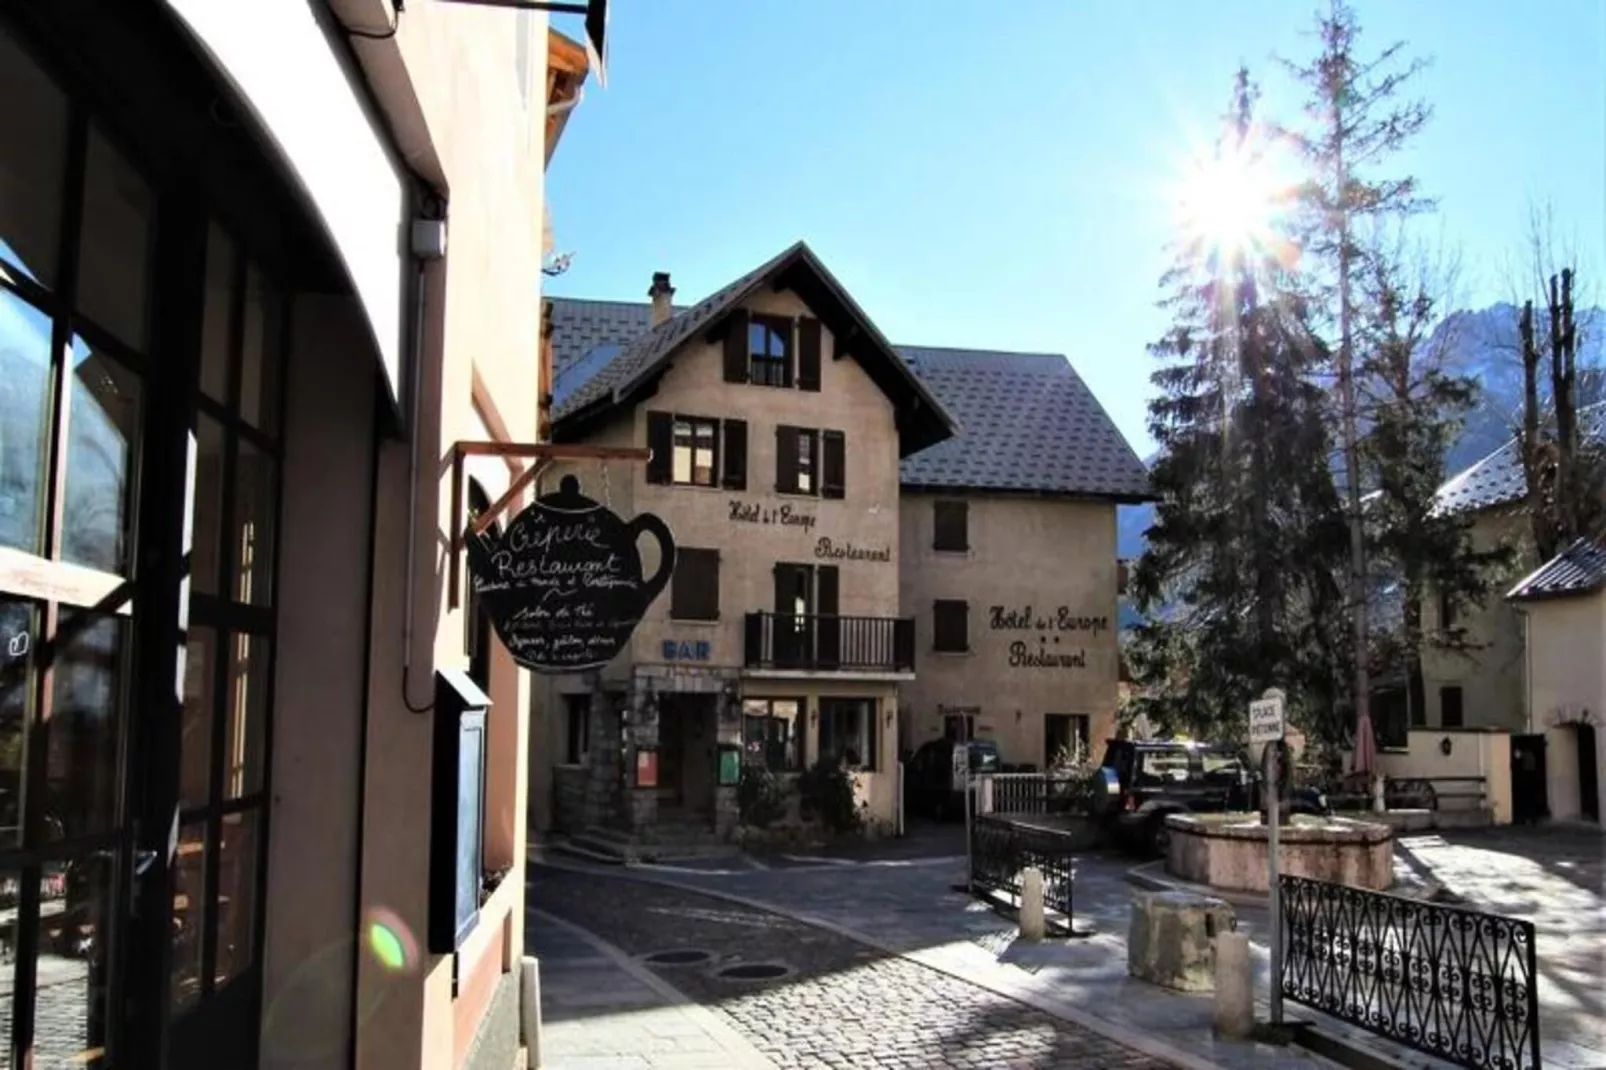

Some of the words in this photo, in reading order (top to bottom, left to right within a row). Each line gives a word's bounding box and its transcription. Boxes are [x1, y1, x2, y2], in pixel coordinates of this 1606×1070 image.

[490, 550, 620, 578] Restaurant
[814, 536, 892, 564] Restaurant
[661, 640, 711, 661] BAR
[1008, 640, 1086, 669] Restaurant
